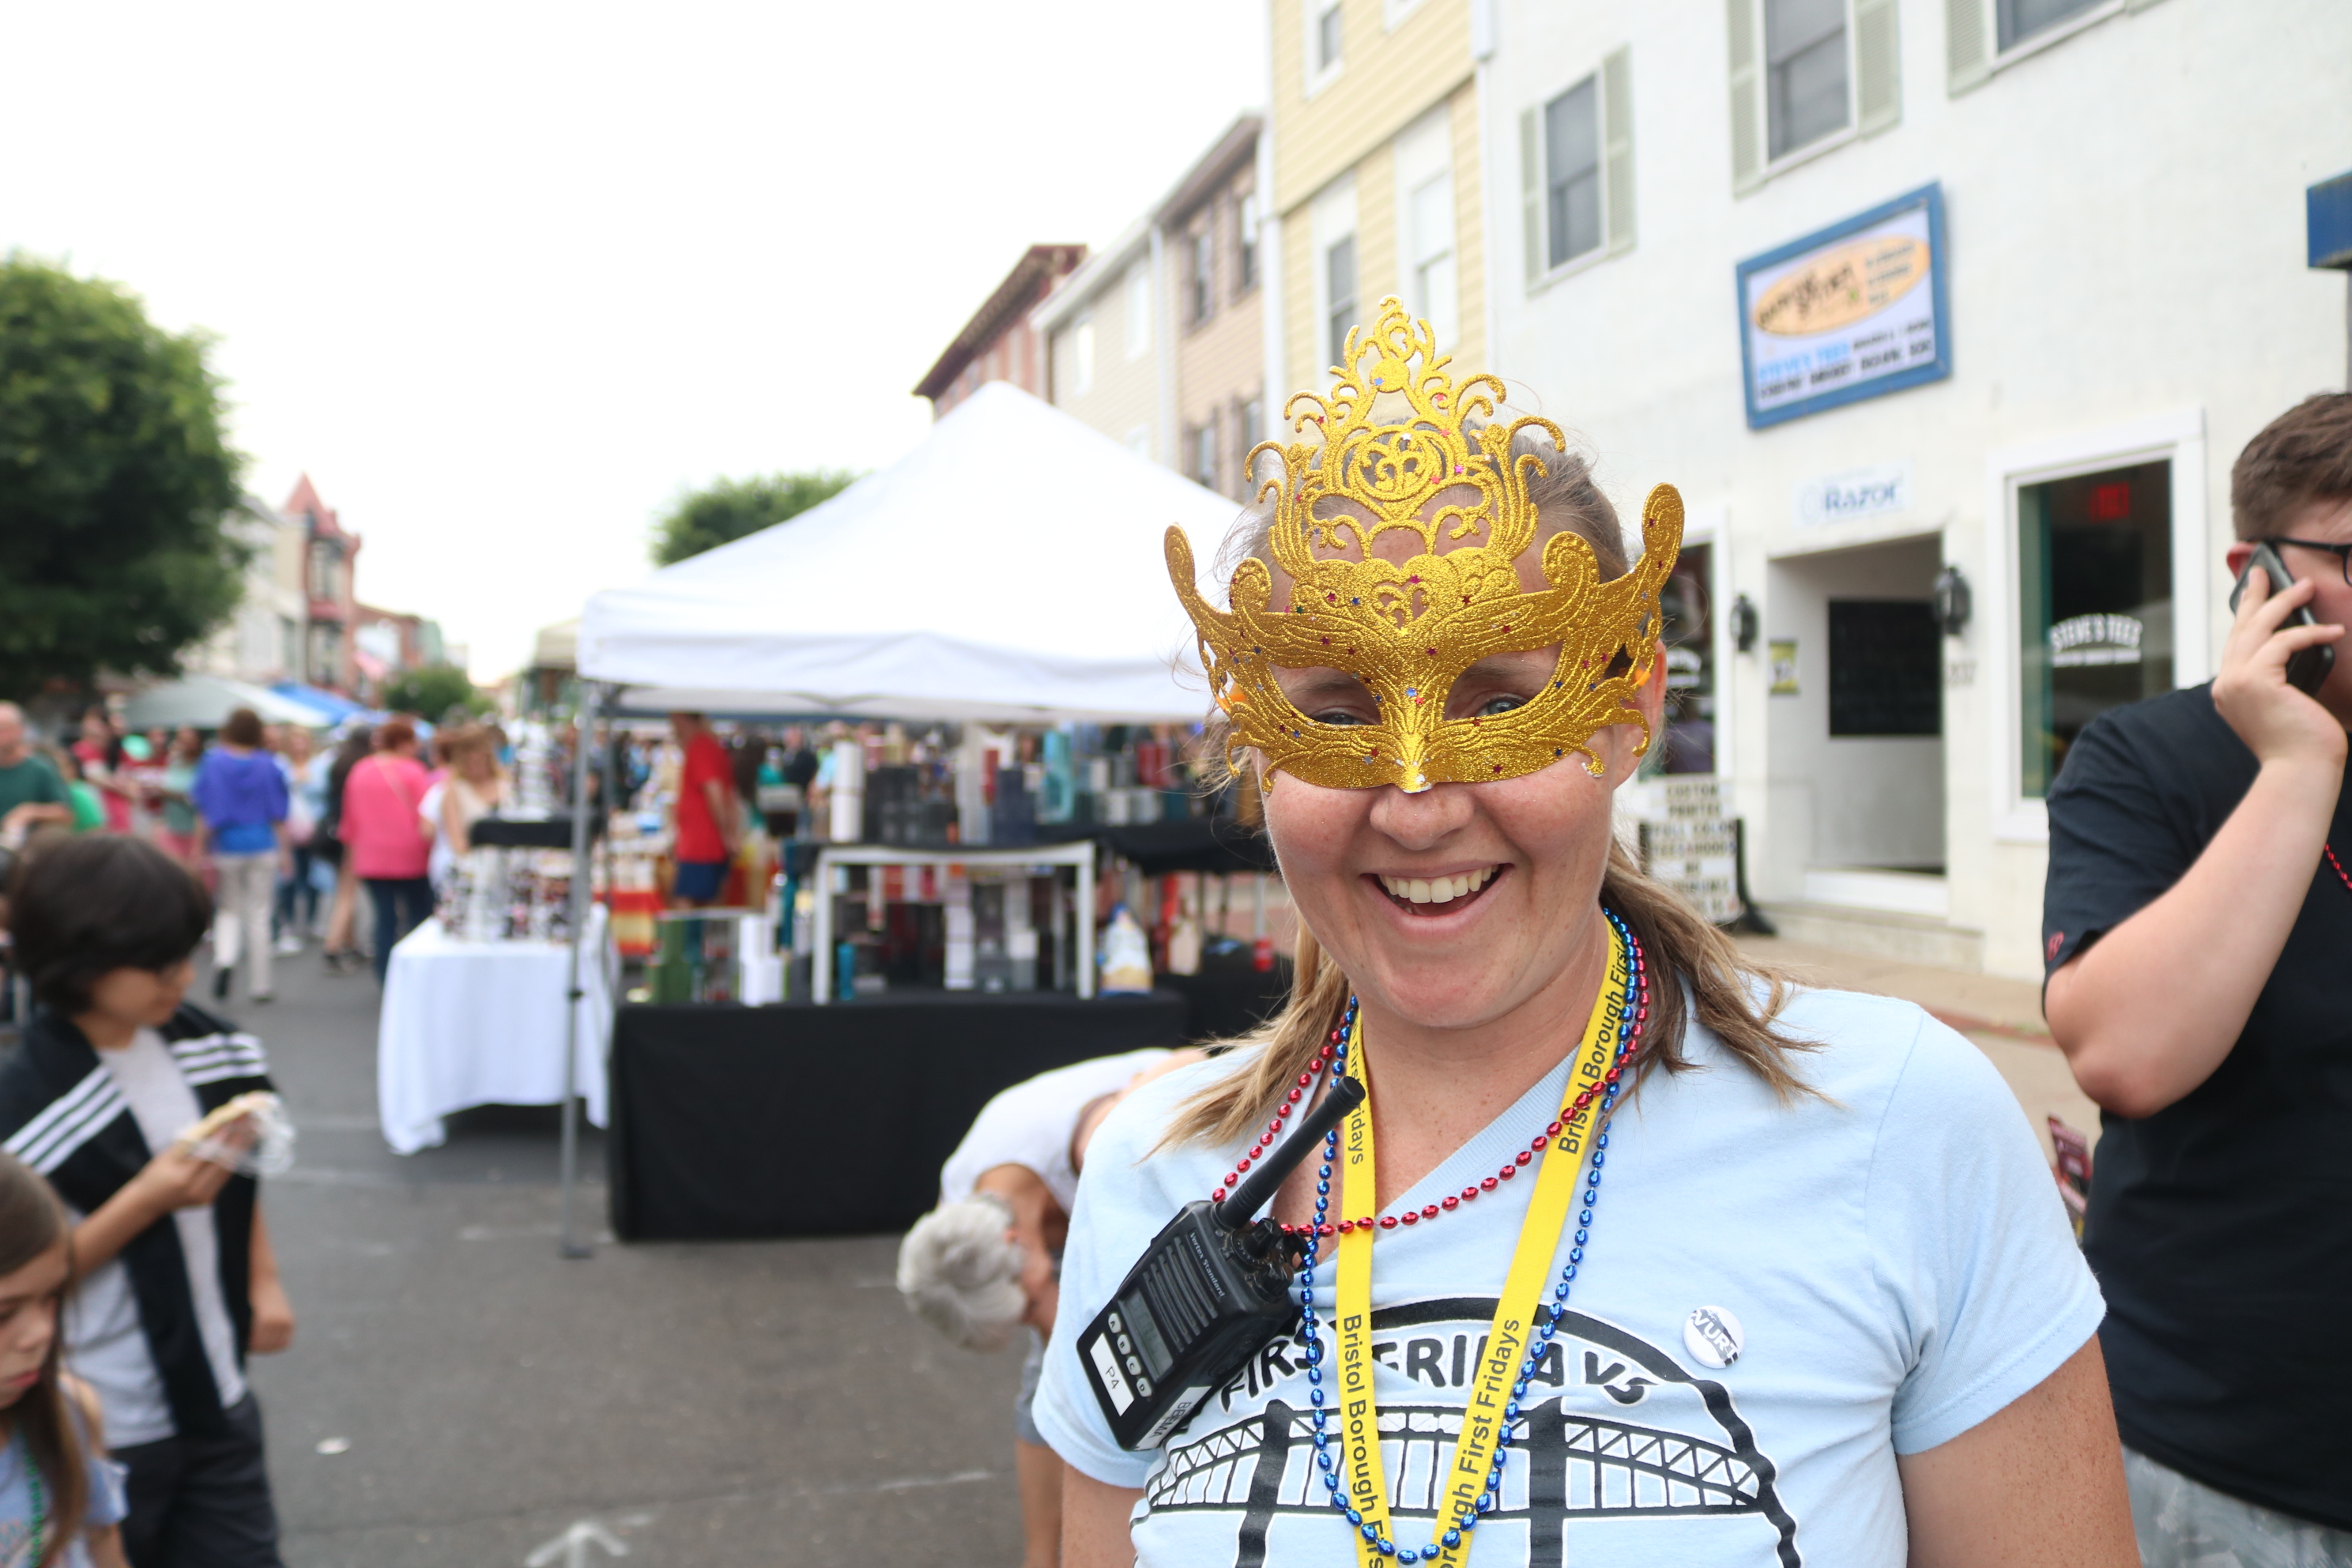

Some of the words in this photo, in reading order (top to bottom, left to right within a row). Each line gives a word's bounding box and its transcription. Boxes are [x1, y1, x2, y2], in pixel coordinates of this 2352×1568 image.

[1351, 1041, 1361, 1082] Firs
[1558, 1082, 1593, 1155] Brisl
[1581, 992, 1624, 1080] Borough
[1348, 1103, 1365, 1165] idays
[1189, 1232, 1204, 1260] Vertex
[1202, 1259, 1225, 1297] Standard
[1105, 1366, 1120, 1390] P4
[1220, 1319, 1326, 1413] FIRS
[1344, 1314, 1365, 1394] Bristol
[1148, 1401, 1193, 1439] BBEMA
[1458, 1415, 1492, 1476] First
[1476, 1319, 1520, 1408] Fridays
[1348, 1399, 1378, 1513] Borough
